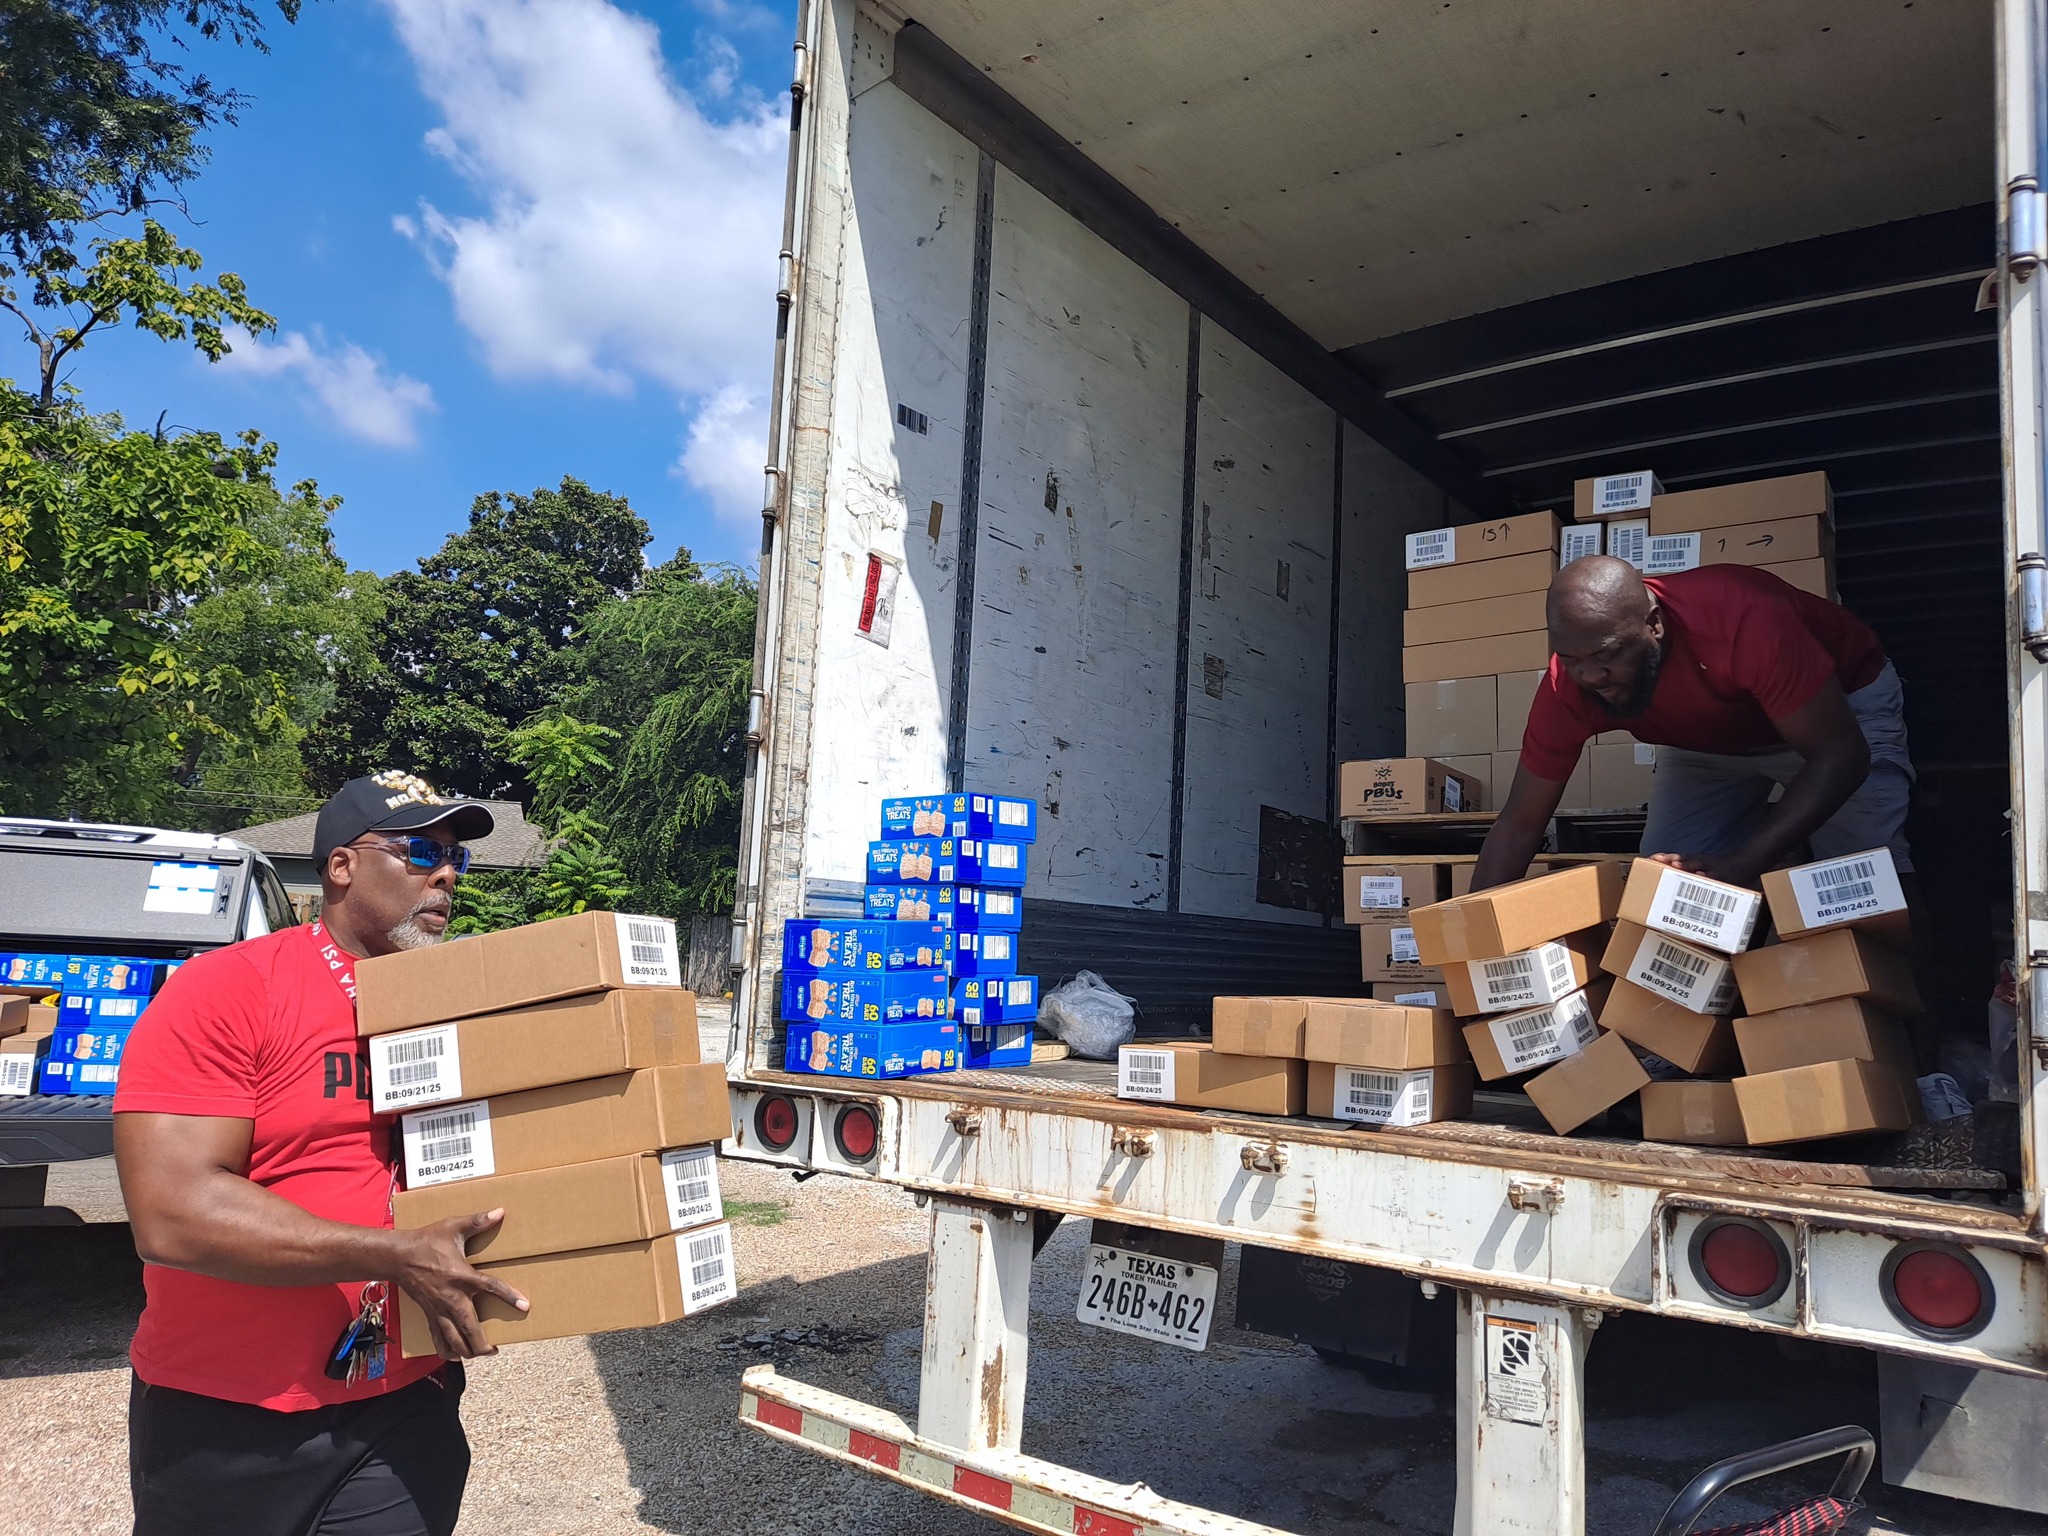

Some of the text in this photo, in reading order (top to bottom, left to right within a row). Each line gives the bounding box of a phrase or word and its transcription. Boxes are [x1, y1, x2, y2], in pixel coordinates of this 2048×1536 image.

[866, 588, 876, 602] LIST
[862, 600, 874, 626] PACKING
[954, 797, 965, 806] 60
[886, 809, 911, 820] TREATS
[942, 840, 952, 850] 60
[872, 854, 898, 863] TREATS
[940, 888, 950, 897] 60
[870, 898, 894, 908] TREATS
[939, 896, 951, 904] BARS
[1816, 898, 1878, 918] BB:09/24/25
[1662, 915, 1719, 939] BB:09/24/25
[843, 932, 852, 966] TREATS
[934, 948, 942, 959] 60
[872, 952, 882, 968] 60
[630, 966, 668, 976] BB:09/21/25
[966, 982, 979, 993] 60
[1640, 971, 1690, 999] BB:09/24/25
[840, 982, 850, 1018] TREATS
[937, 998, 945, 1009] 60
[1488, 992, 1534, 1004] BB:09/24/25
[870, 1004, 880, 1021] 60
[888, 1009, 904, 1018] TREATS
[840, 1034, 850, 1072] TREATS
[945, 1050, 954, 1060] 60
[1514, 1045, 1562, 1064] BB:09/24/25
[868, 1058, 877, 1075] 60
[886, 1062, 904, 1072] TREATS
[385, 1083, 442, 1100] BB:09/21/25
[1126, 1086, 1162, 1094] BB:09/24/25
[1345, 1106, 1392, 1117] BB:09/24/25
[418, 1159, 474, 1176] BB:09/24/25
[678, 1202, 712, 1218] BB:09/24/25
[1127, 1256, 1176, 1280] TEXAS
[1121, 1270, 1178, 1290] TOKEN TRAILER
[692, 1282, 727, 1302] BB:09/24/25
[1086, 1274, 1206, 1334] 246B 462
[1138, 1324, 1152, 1332] Star
[1153, 1328, 1170, 1336] State
